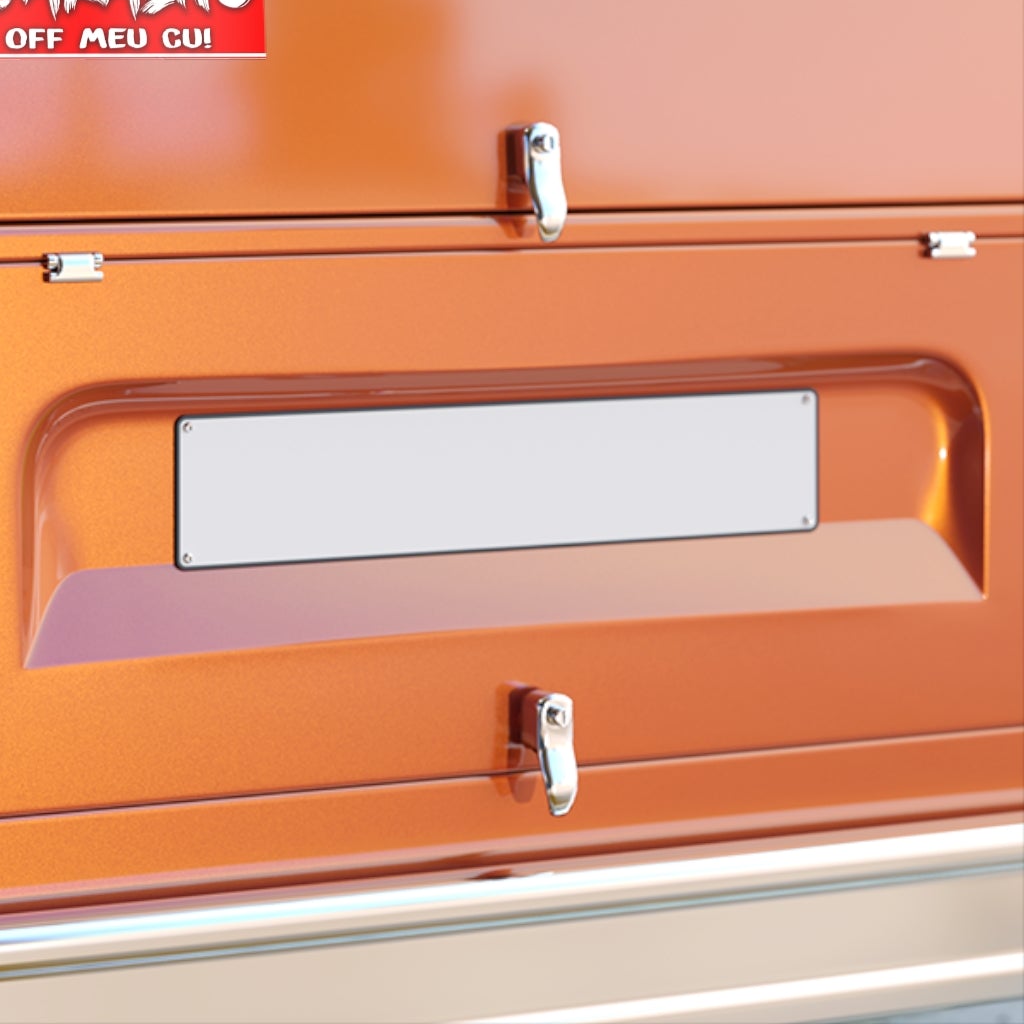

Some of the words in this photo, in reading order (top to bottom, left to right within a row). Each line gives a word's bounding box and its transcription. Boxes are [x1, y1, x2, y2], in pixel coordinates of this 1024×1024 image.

[5, 27, 64, 50] OFF
[79, 27, 148, 49] MEU
[162, 27, 212, 49] CU!
